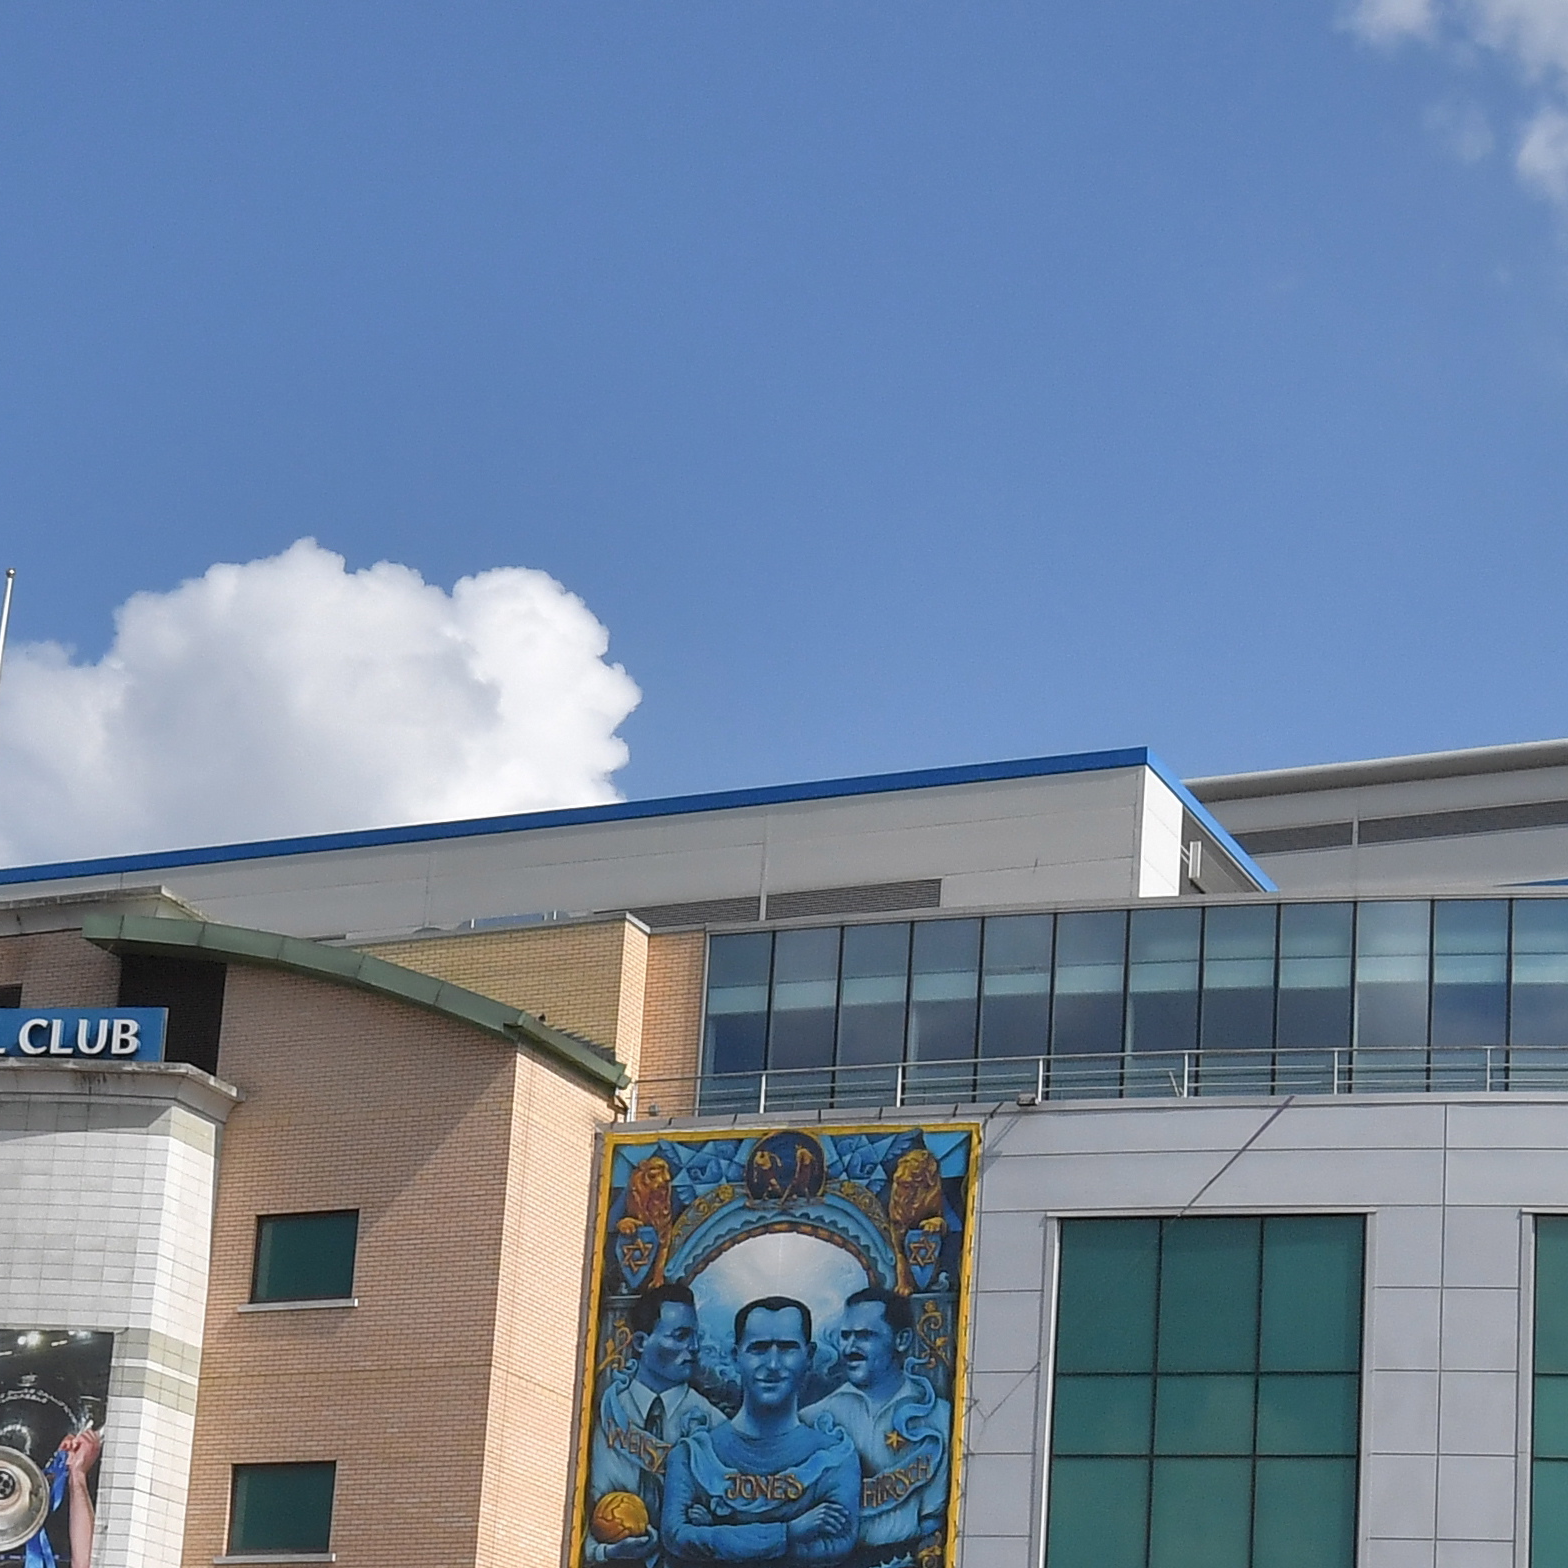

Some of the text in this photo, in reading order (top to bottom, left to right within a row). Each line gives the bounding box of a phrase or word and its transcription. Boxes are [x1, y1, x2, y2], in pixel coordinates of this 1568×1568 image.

[18, 1018, 142, 1055] CLUB
[607, 1418, 674, 1474] WEISZ
[724, 1472, 804, 1499] JONES
[862, 1454, 933, 1508] HIRSCH
